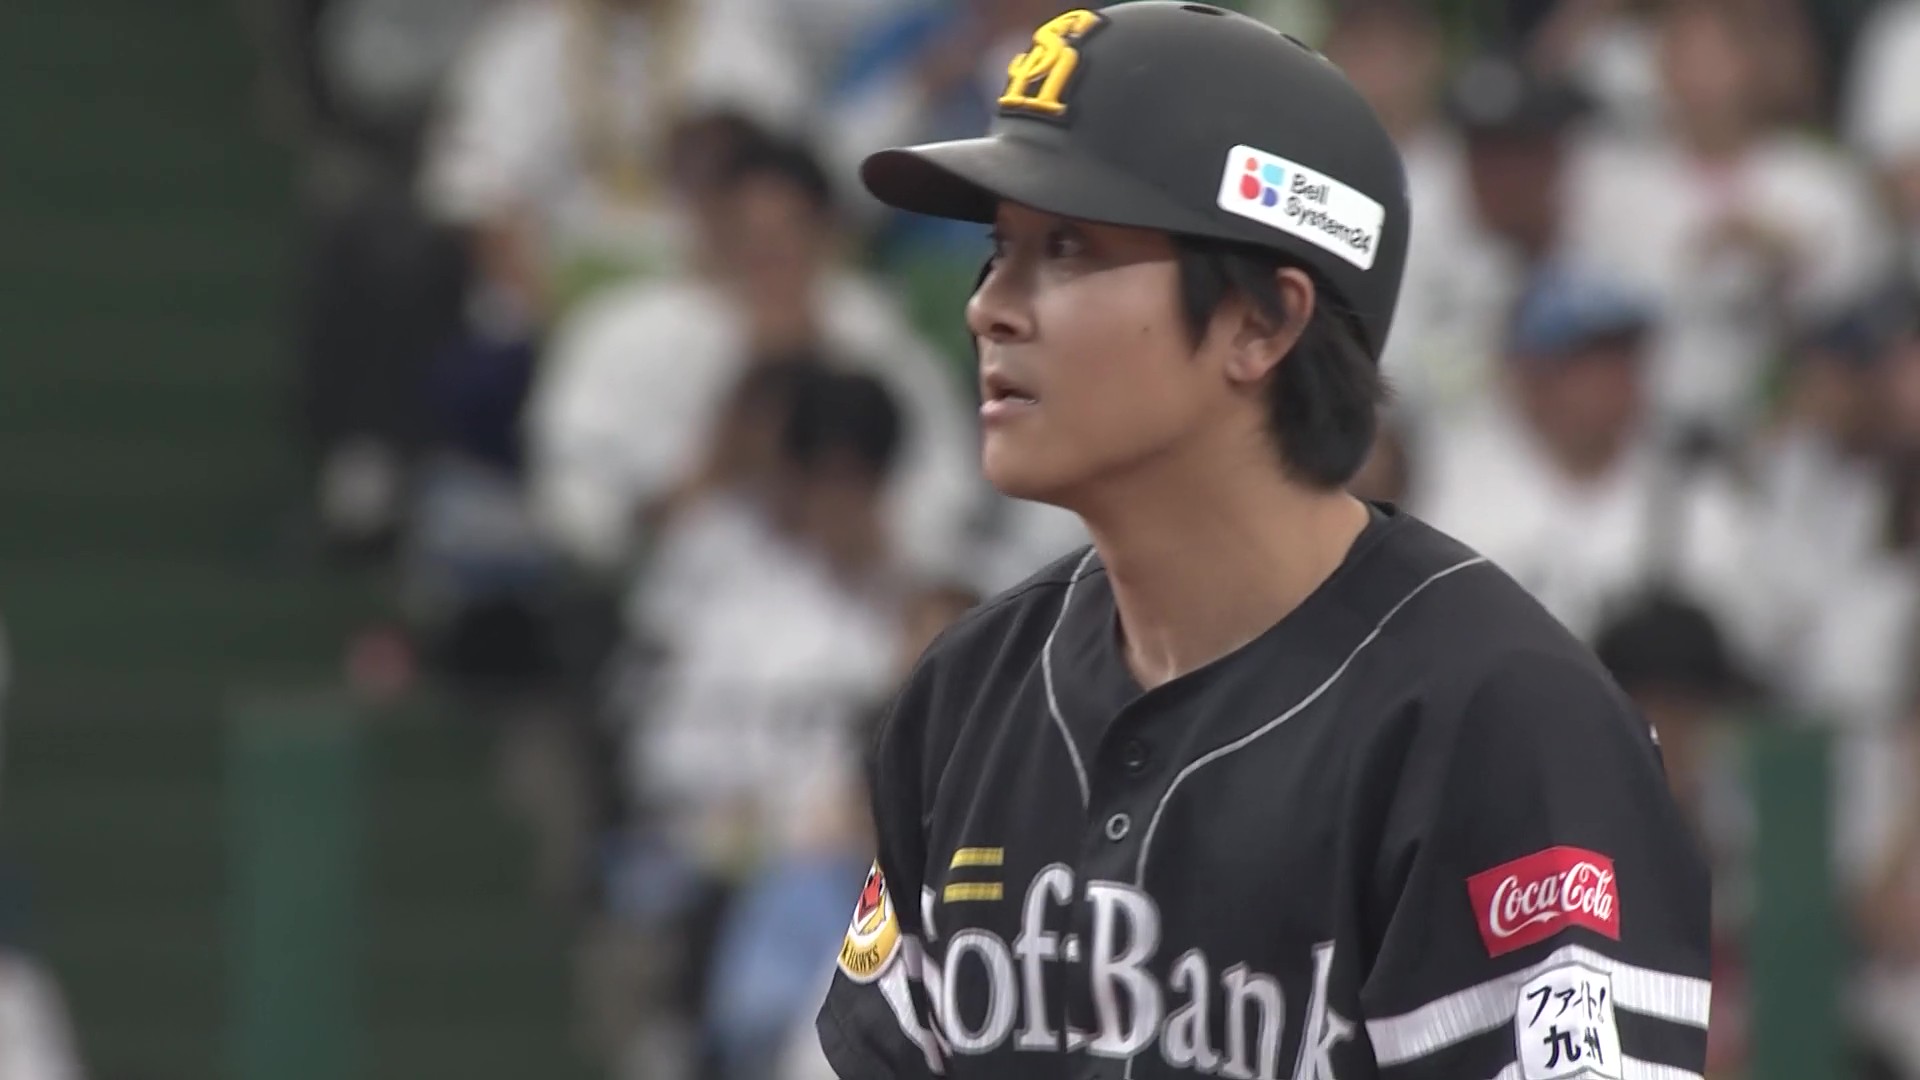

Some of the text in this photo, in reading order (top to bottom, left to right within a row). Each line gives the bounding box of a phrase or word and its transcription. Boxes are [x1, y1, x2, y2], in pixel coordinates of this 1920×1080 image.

[1290, 173, 1330, 205] Bell
[1283, 195, 1372, 254] System24
[847, 944, 880, 973] HAWKS
